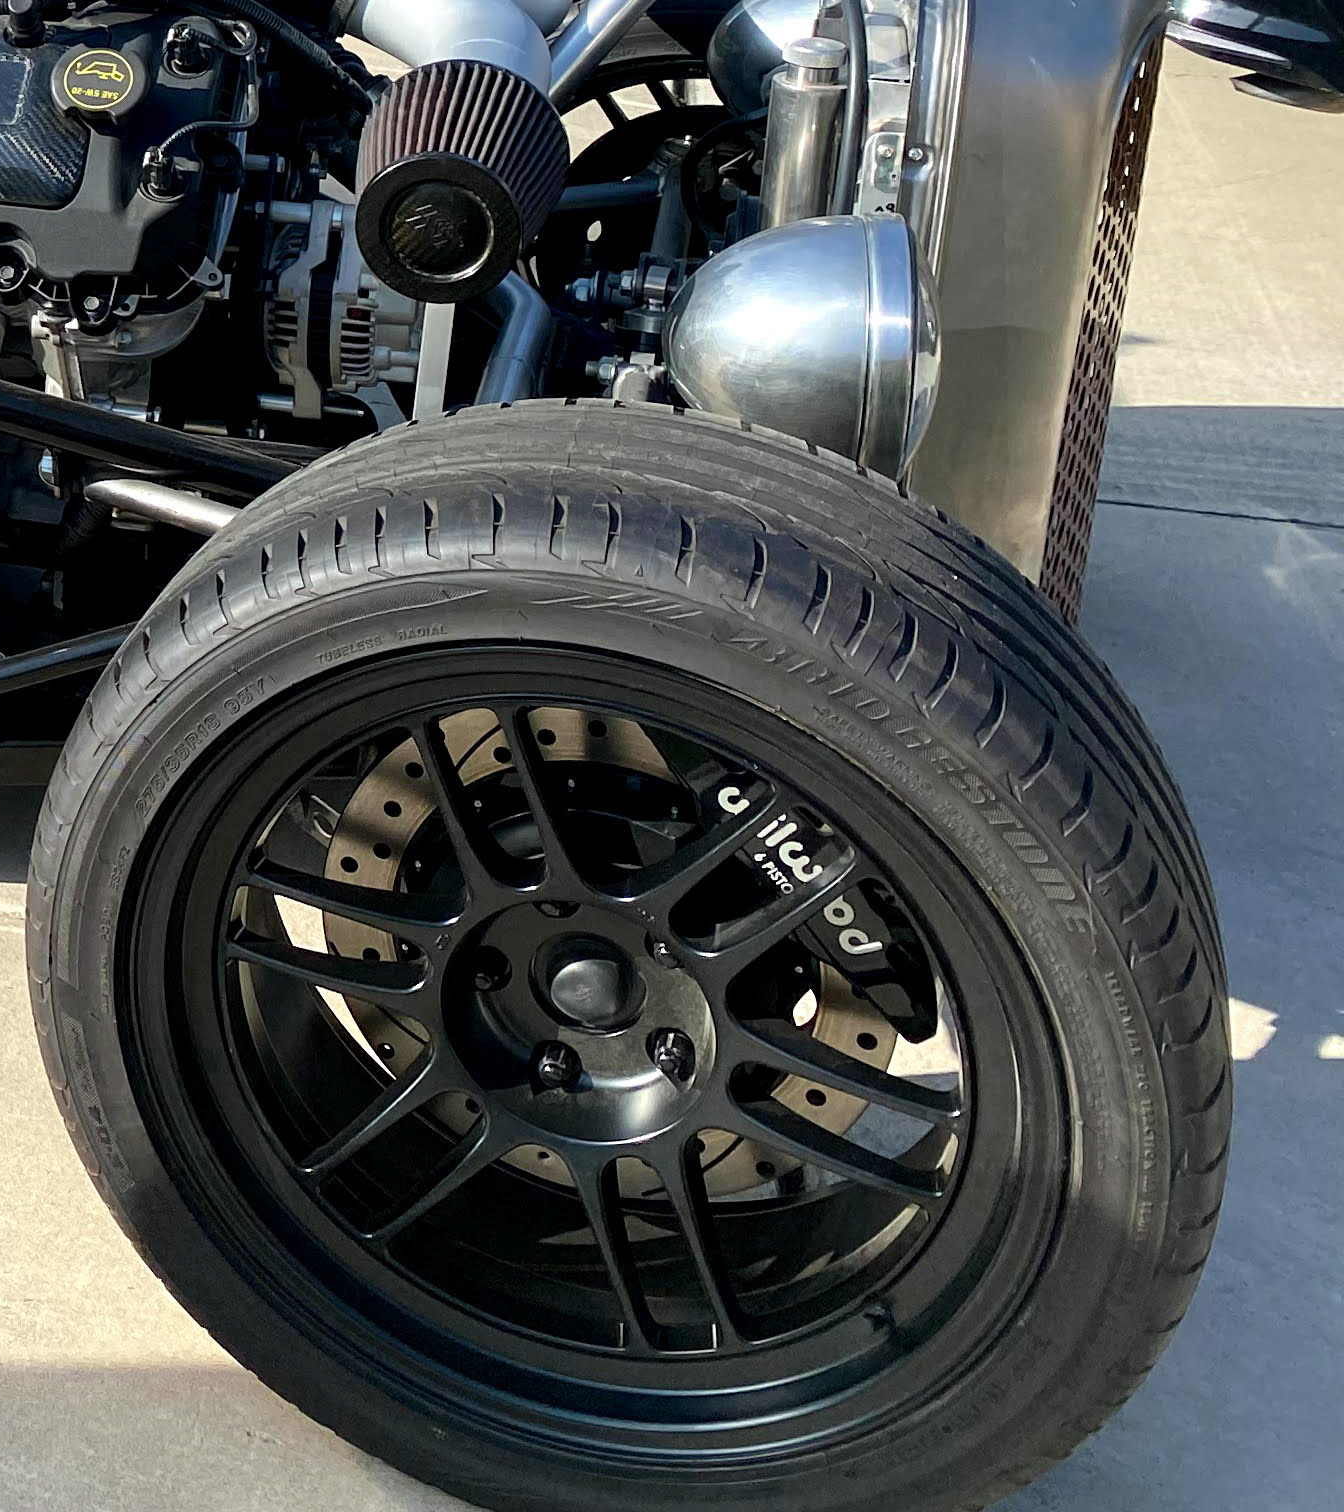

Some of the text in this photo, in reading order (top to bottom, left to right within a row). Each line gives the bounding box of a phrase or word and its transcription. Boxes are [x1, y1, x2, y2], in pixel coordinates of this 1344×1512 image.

[101, 90, 120, 101] SAE
[316, 623, 448, 665] TUBELESS RADIAL
[726, 634, 1100, 936] BRIDGESTONE
[717, 785, 884, 956] wilwod
[761, 860, 795, 895] PISTO
